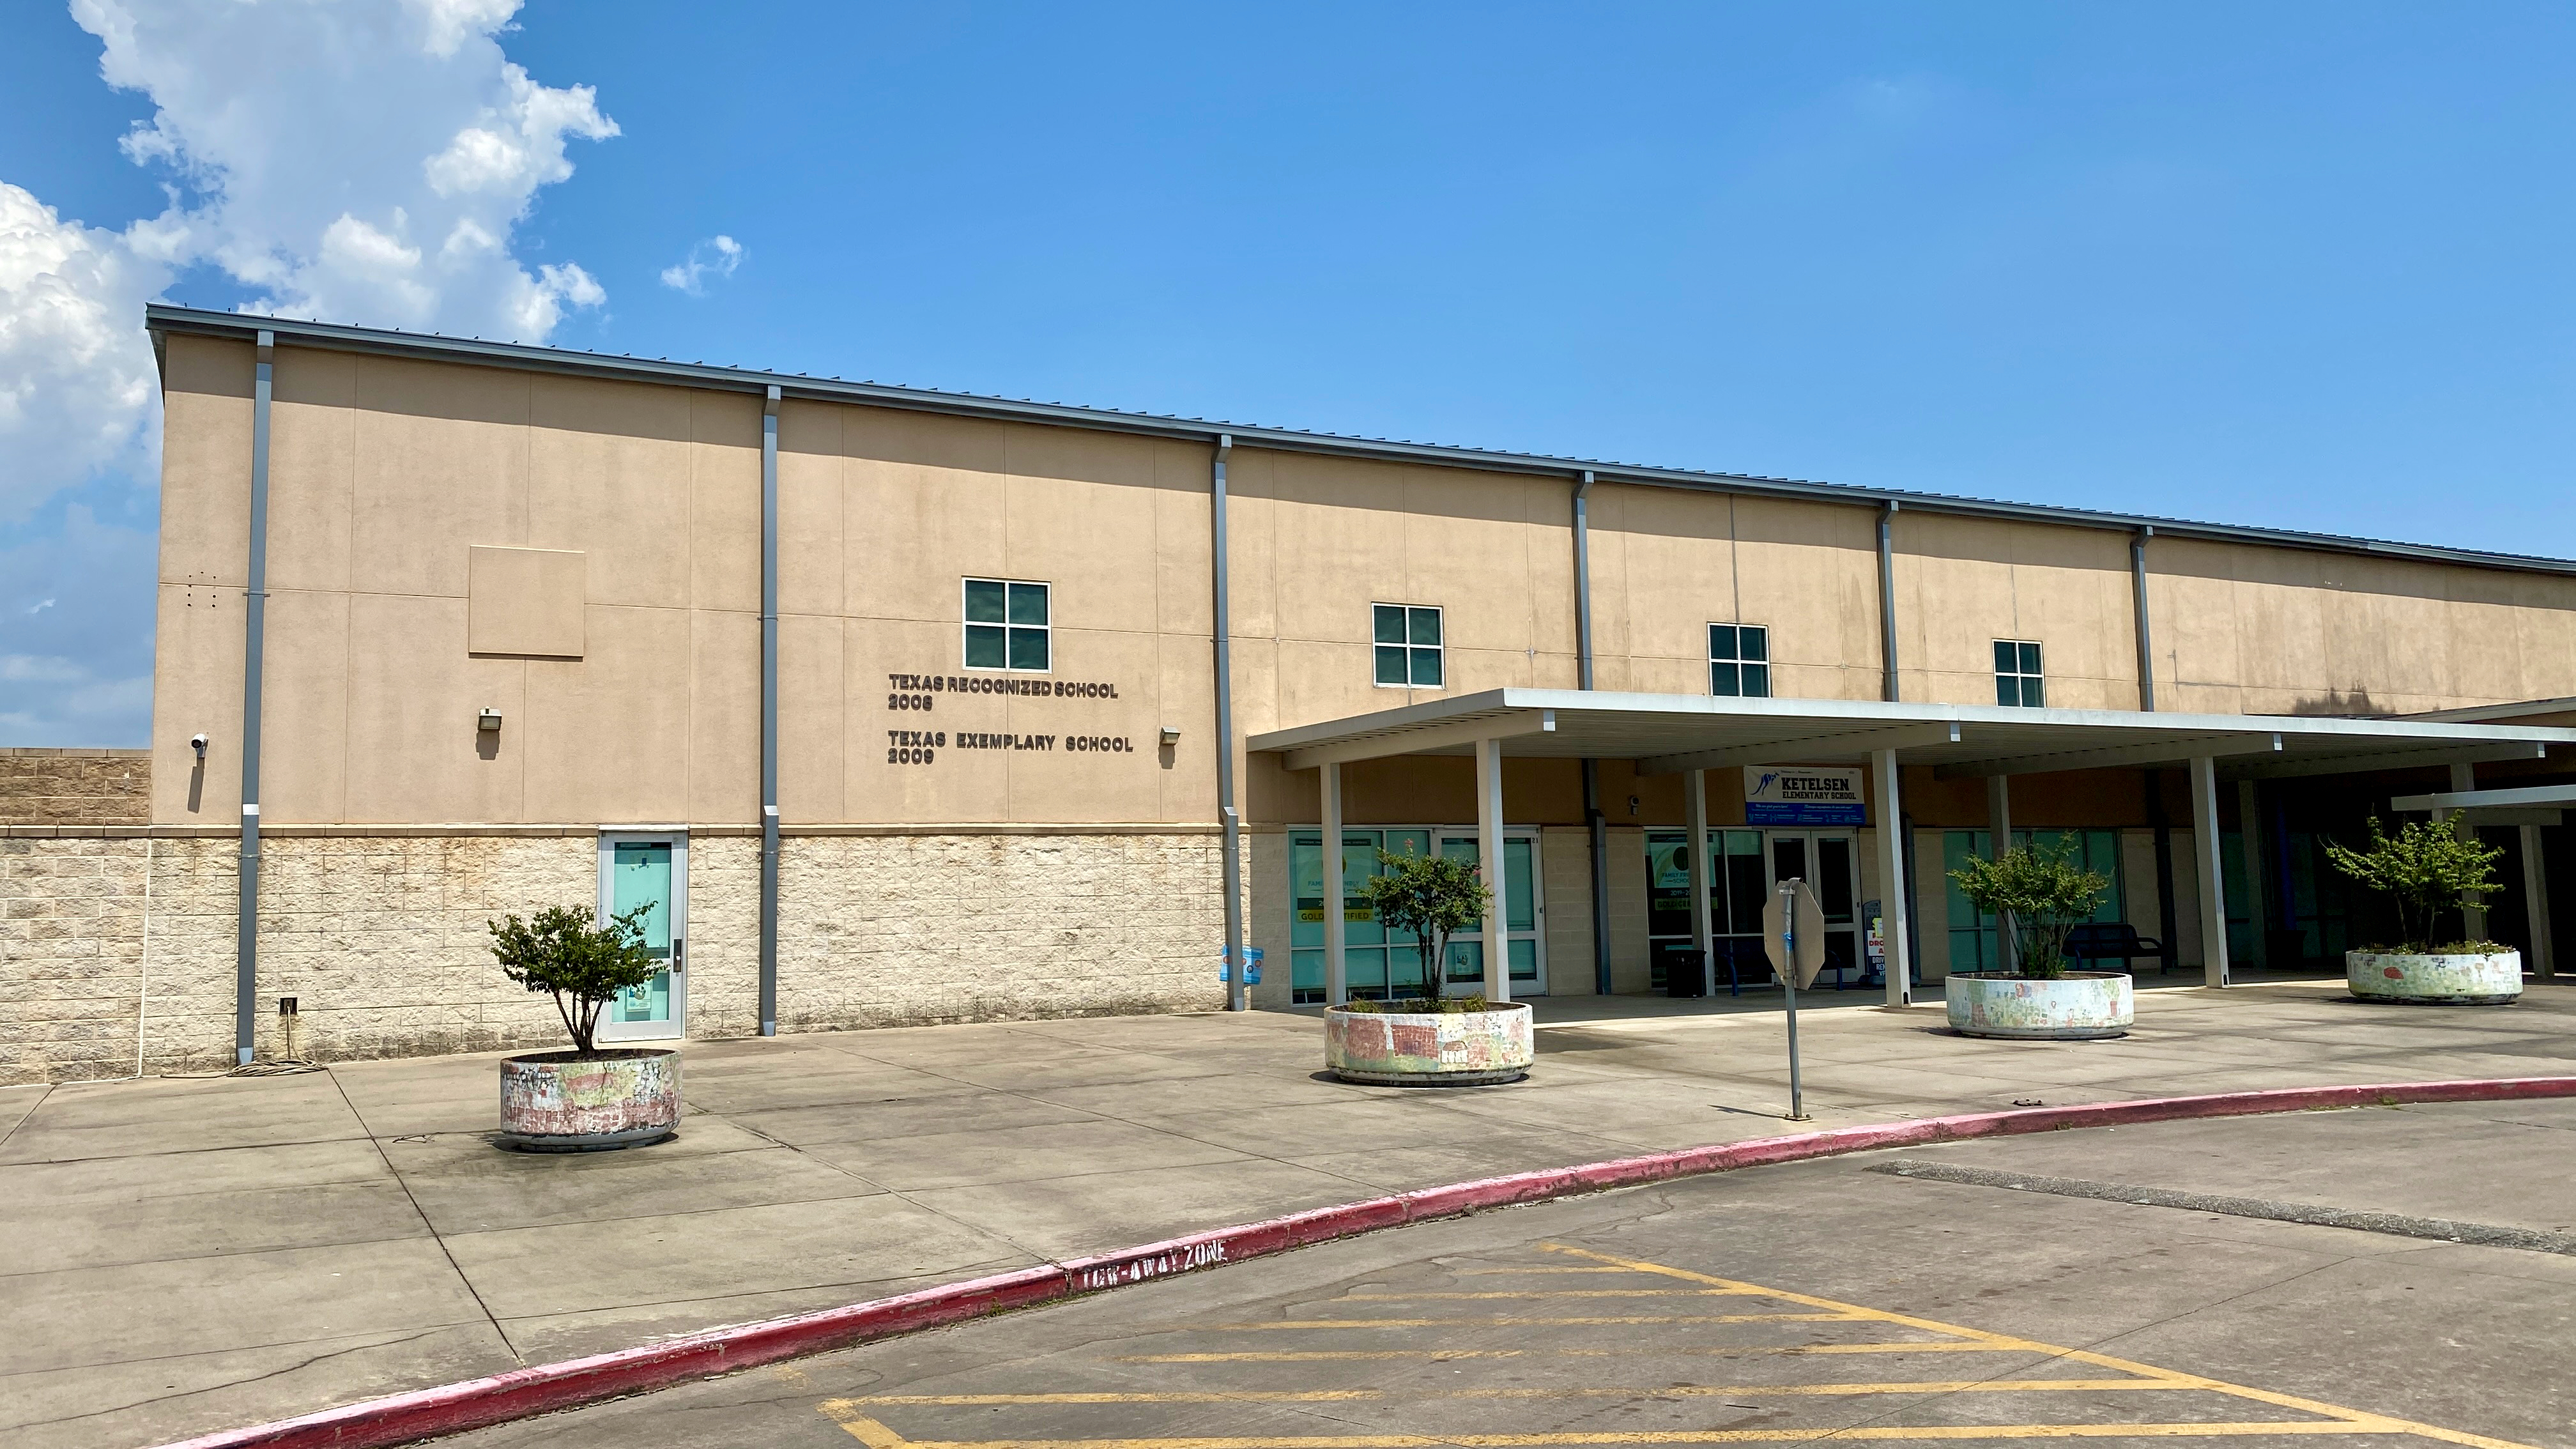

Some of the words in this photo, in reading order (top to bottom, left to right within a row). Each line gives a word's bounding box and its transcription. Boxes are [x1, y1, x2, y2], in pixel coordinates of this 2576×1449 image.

[889, 673, 944, 692] TEXAS
[947, 676, 1052, 696] RECOGNIZED
[1054, 681, 1119, 699] SCHOOL
[888, 693, 933, 711] 2008
[887, 730, 946, 747] TEXAS
[956, 732, 1056, 751] EXEMPLARY
[1066, 735, 1133, 753] SCHOOL
[887, 747, 934, 765] 2009
[1781, 777, 1850, 792] KETELSEN
[1782, 791, 1830, 799] ELEMENTARY
[1831, 792, 1857, 800] SCHOOL
[1183, 1239, 1228, 1271] ZONE
